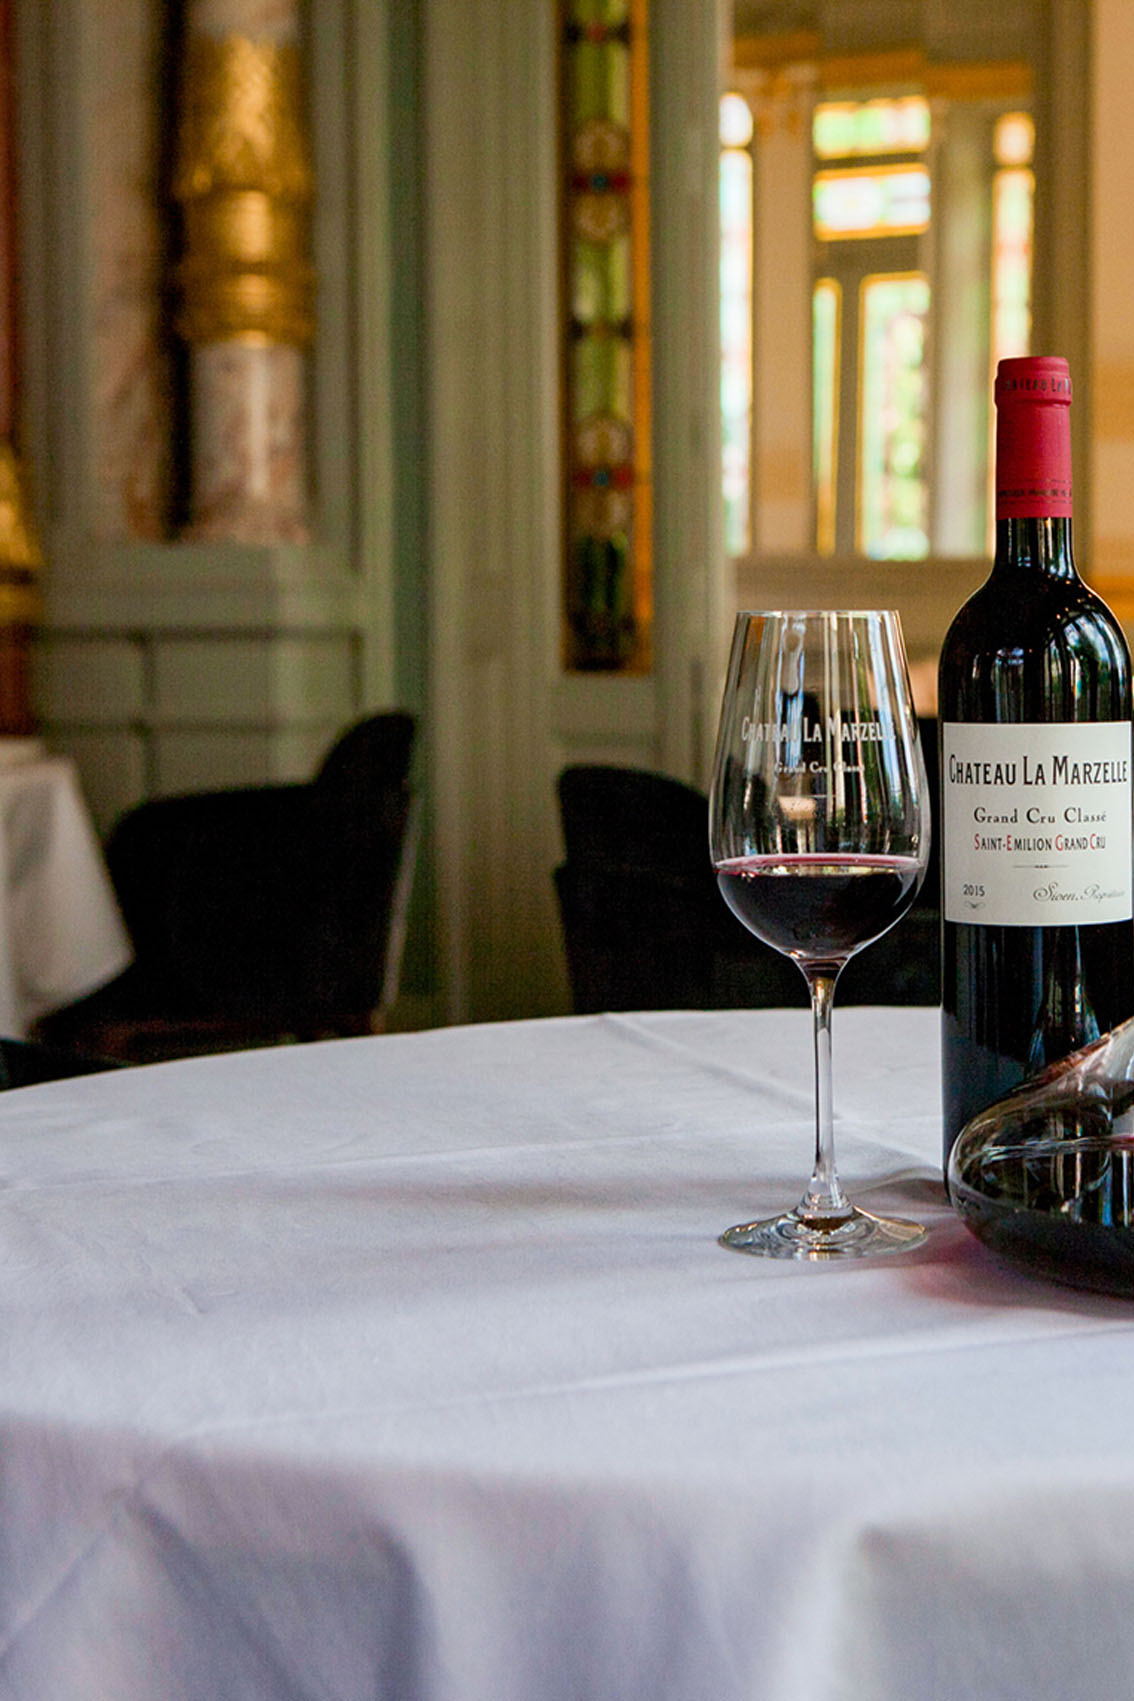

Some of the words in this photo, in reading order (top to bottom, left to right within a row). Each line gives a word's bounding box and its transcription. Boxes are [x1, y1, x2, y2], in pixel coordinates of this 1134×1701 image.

[803, 717, 823, 742] LA
[826, 716, 896, 742] MARZELE
[949, 754, 1017, 786] CHATEAU
[1022, 755, 1046, 786] LA
[1052, 755, 1128, 786] MARZELLE
[973, 806, 1019, 824] Grand
[1026, 807, 1056, 825] Cru
[1063, 806, 1107, 824] Classé
[973, 833, 1053, 851] SAINT-EMILION
[1055, 833, 1089, 852] GRAND
[1089, 833, 1106, 850] CRU
[963, 883, 986, 897] 2015
